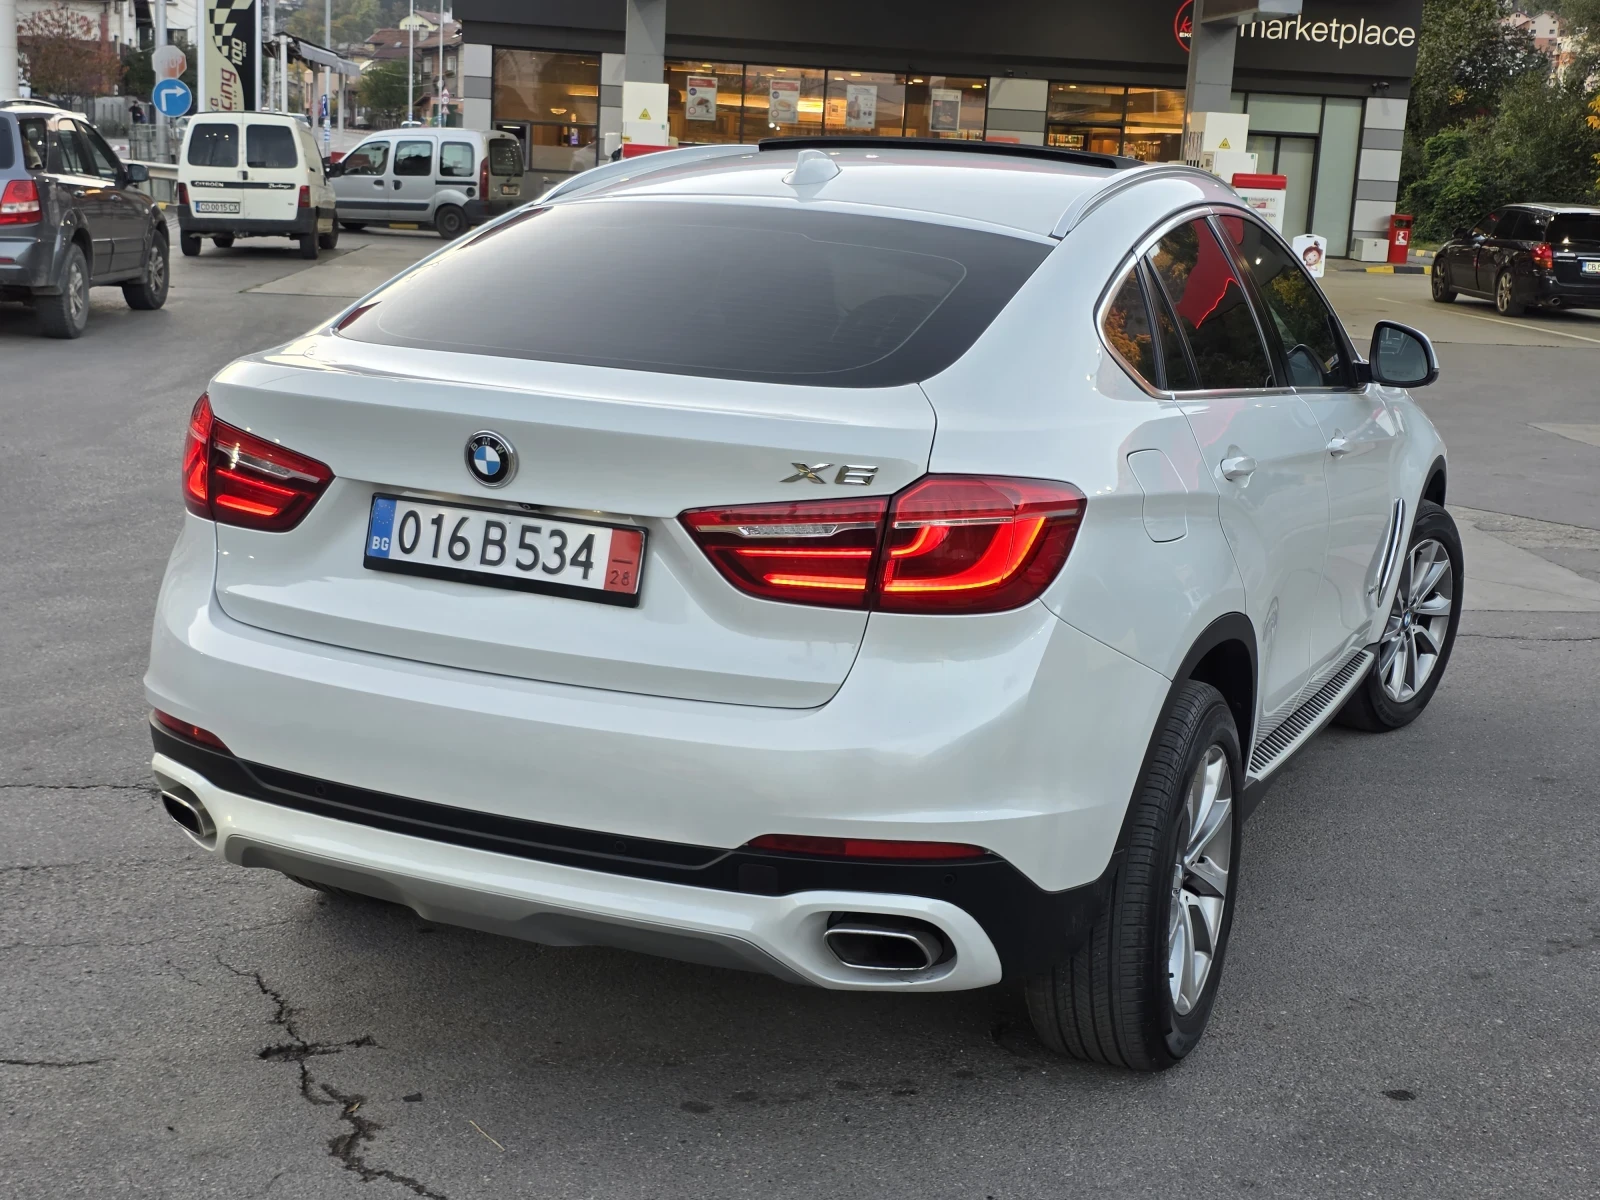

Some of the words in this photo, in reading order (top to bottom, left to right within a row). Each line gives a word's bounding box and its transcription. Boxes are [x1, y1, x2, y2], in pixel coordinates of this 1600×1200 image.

[1240, 14, 1416, 49] marketplace
[231, 37, 243, 65] 100
[470, 437, 505, 454] BMW
[779, 462, 879, 486] X6
[371, 535, 390, 551] BG
[398, 509, 595, 580] 016B534
[609, 569, 631, 587] 28
